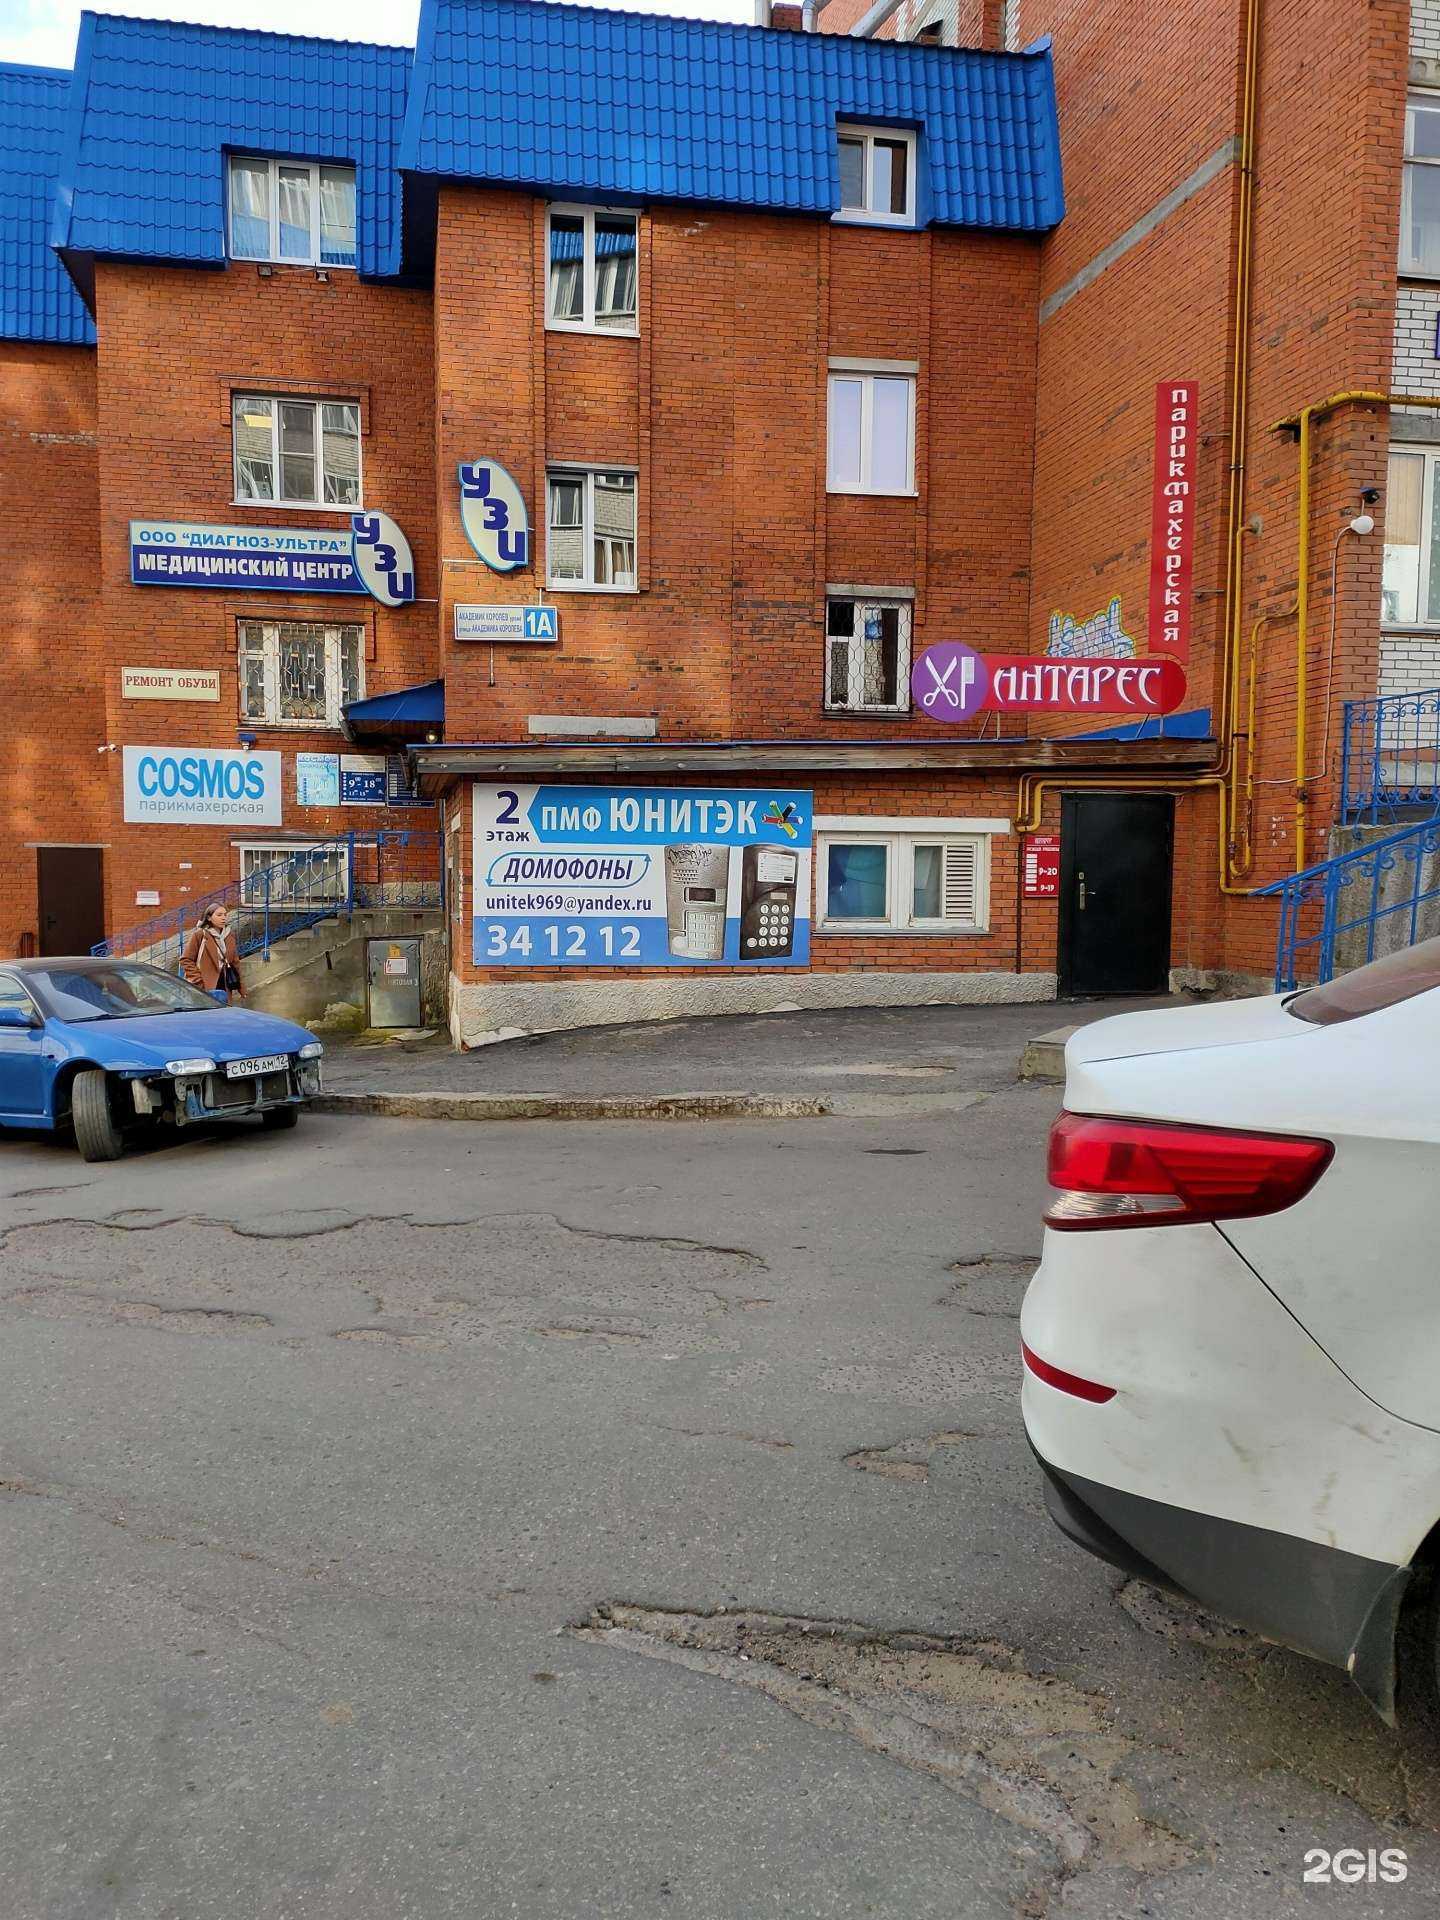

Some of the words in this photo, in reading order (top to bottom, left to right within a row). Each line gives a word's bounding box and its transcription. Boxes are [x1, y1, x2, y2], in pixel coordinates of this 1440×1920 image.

[461, 466, 526, 562] УЗИ
[1163, 388, 1189, 641] парикмахерская
[139, 530, 177, 544] ООО
[139, 553, 289, 577] МЕДИЦИНСКИЙ
[292, 561, 354, 580] ЦЕНТР
[353, 517, 413, 600] УЗИ
[526, 611, 553, 636] 1А
[125, 675, 173, 688] РЕМОНТ
[177, 677, 217, 689] ОБУВИ
[993, 664, 1161, 705] АНТАРЕС
[138, 756, 265, 800] COSMOS
[139, 799, 265, 816] парикмахерская
[496, 790, 520, 825] 2
[541, 806, 602, 832] ПМФ
[609, 797, 758, 835] ЮНИТЭК
[486, 830, 530, 843] этаж
[503, 857, 633, 883] ДОМОФОНЫ
[486, 893, 652, 914] unitek969@yandex.ru
[487, 924, 533, 957] 34
[544, 924, 587, 957] 12
[599, 925, 641, 957] 12
